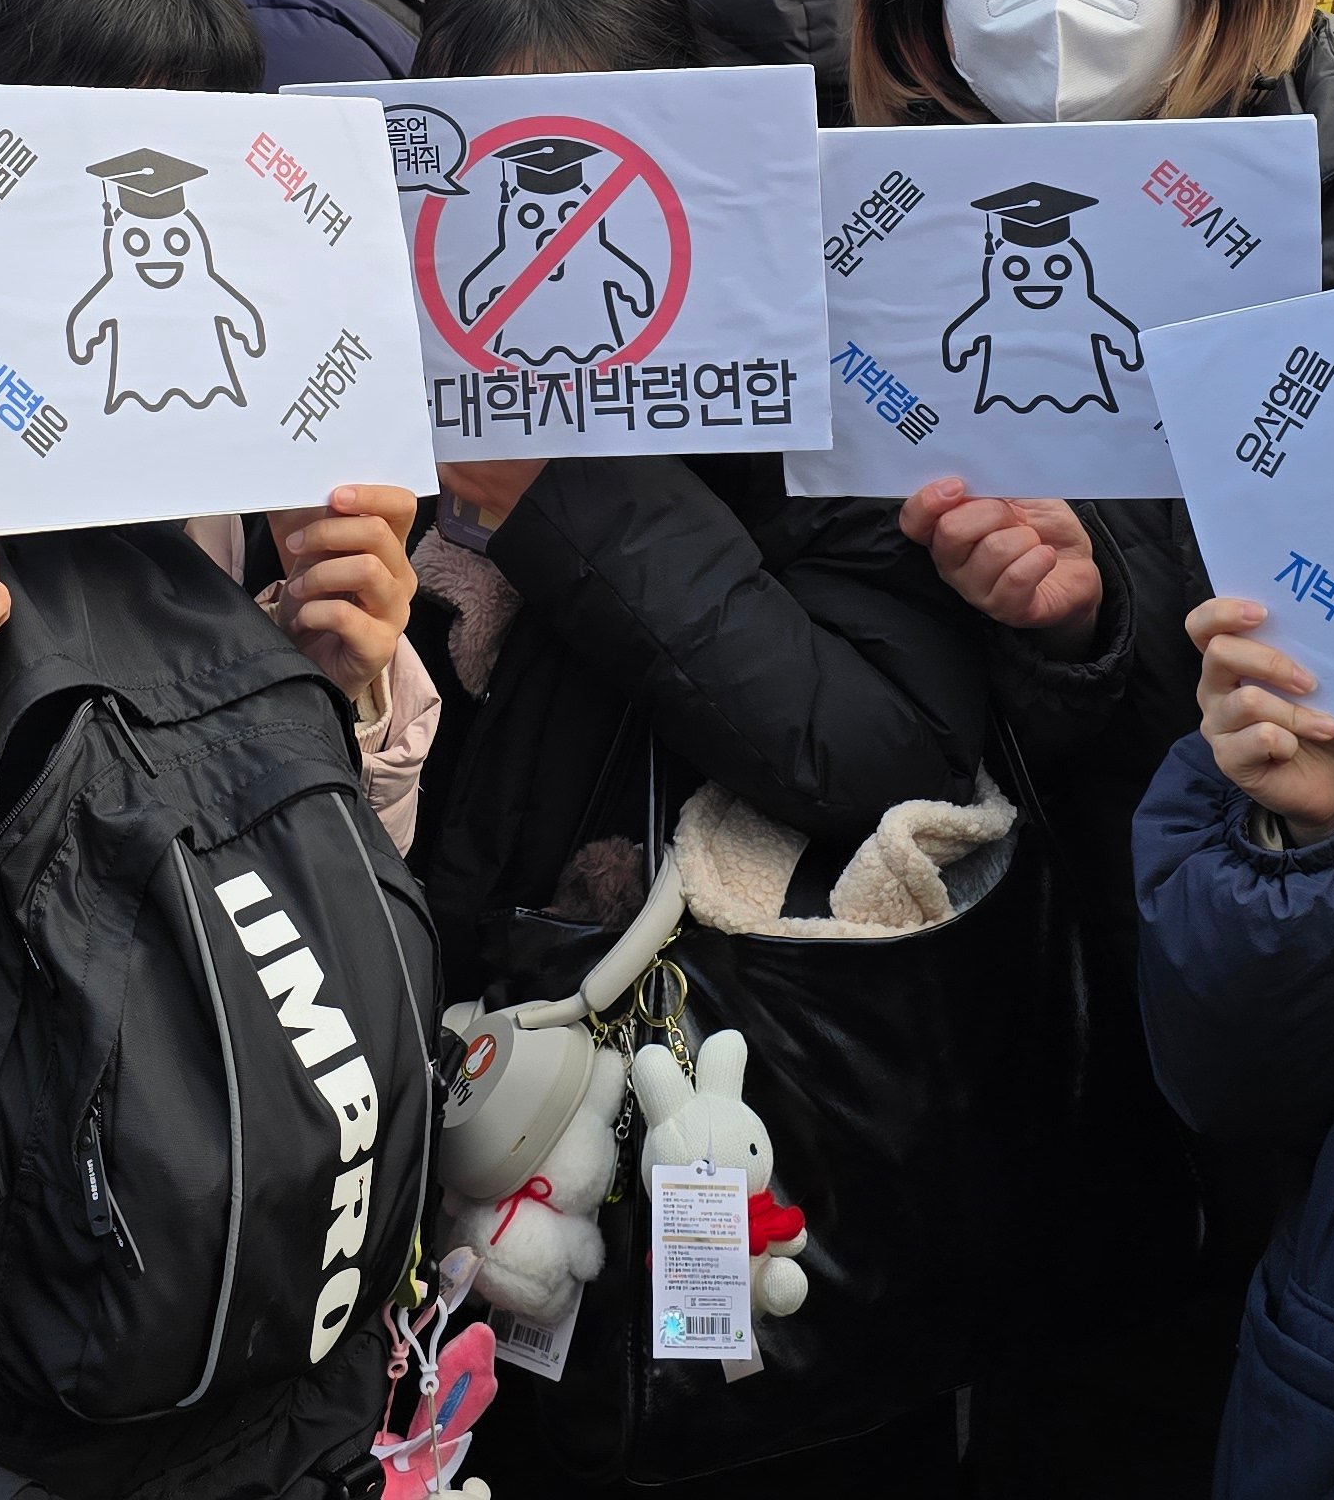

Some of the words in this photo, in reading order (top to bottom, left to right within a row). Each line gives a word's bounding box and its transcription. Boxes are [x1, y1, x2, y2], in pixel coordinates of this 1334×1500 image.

[386, 116, 428, 145] 졸업
[244, 131, 354, 248] 탄핵시켜
[823, 170, 925, 277] 윤석열을
[1141, 159, 1262, 269] 탄핵시켜
[280, 328, 373, 443] 구마하자
[426, 358, 797, 438] 대학지박령연합
[830, 341, 941, 446] 지박령을
[214, 871, 378, 1364] UMBRO
[451, 1075, 473, 1107] iffy
